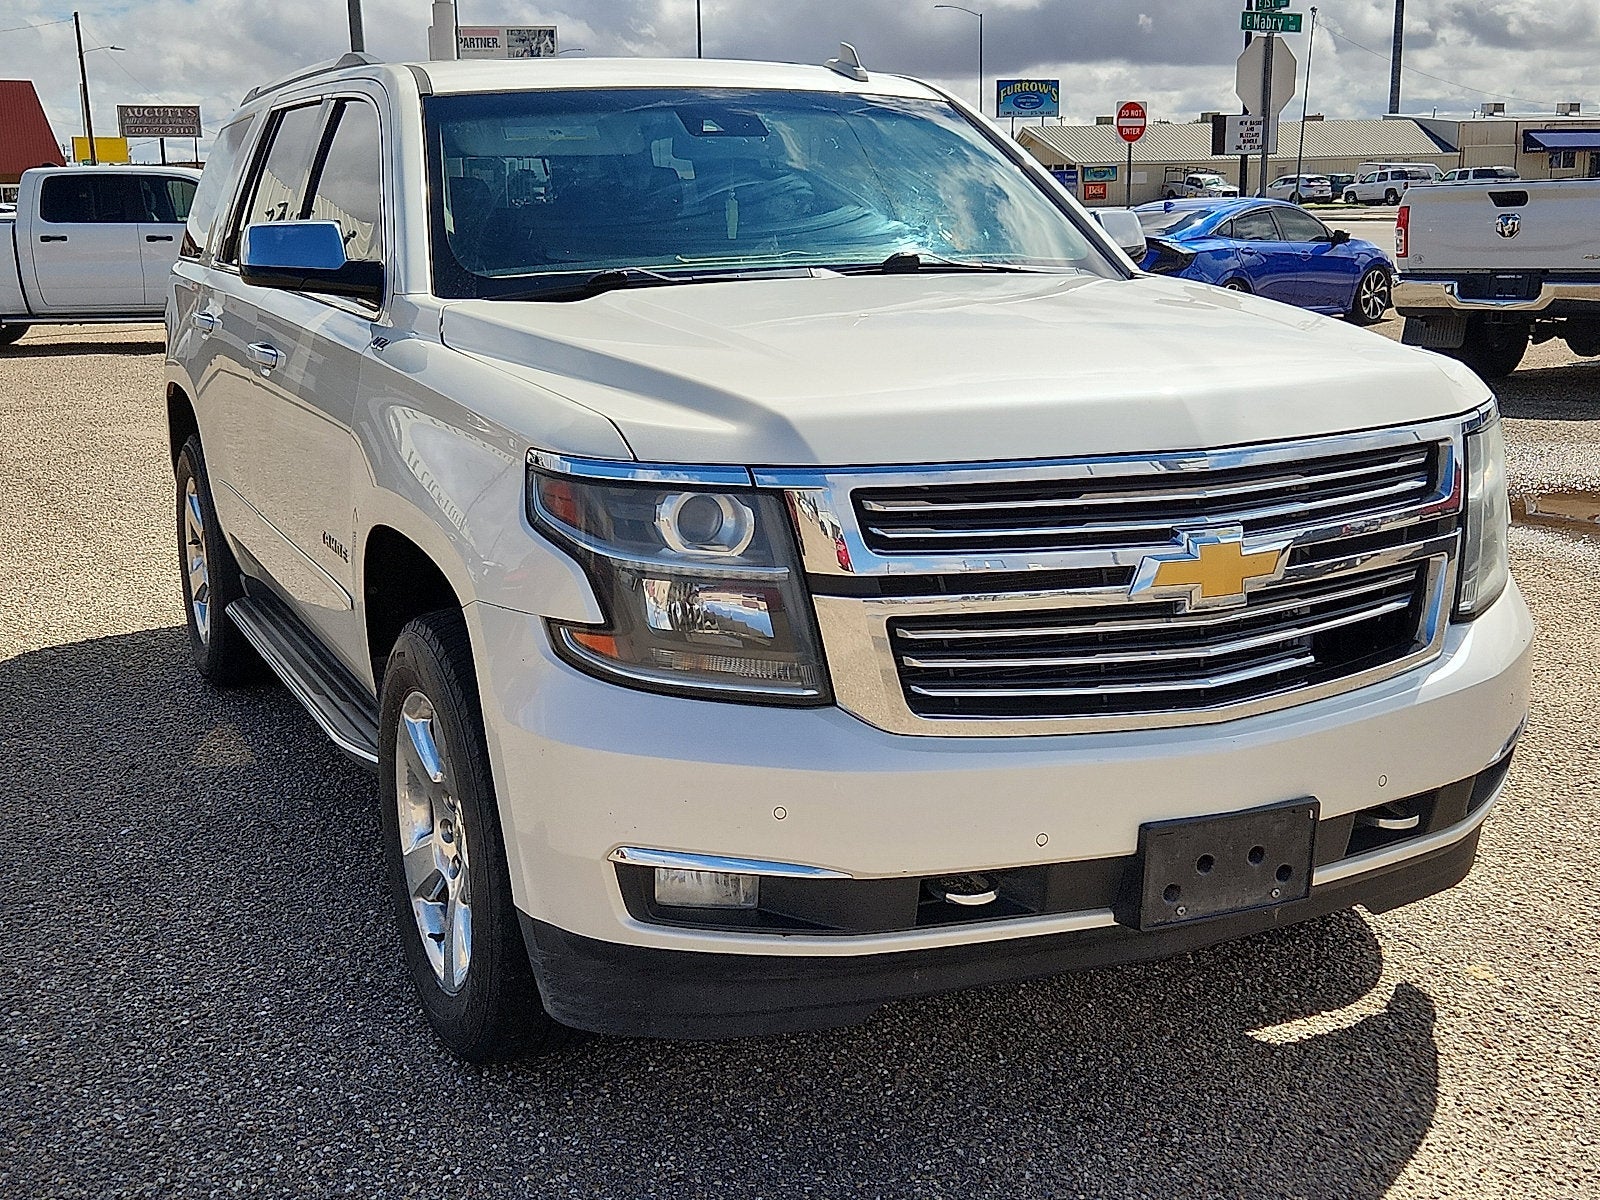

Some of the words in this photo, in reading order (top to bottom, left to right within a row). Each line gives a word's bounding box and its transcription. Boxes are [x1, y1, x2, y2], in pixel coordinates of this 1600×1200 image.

[1246, 15, 1251, 27] E
[1253, 14, 1283, 32] Mabry
[125, 107, 197, 118] AUCUTT'S
[1088, 186, 1104, 195] Best
